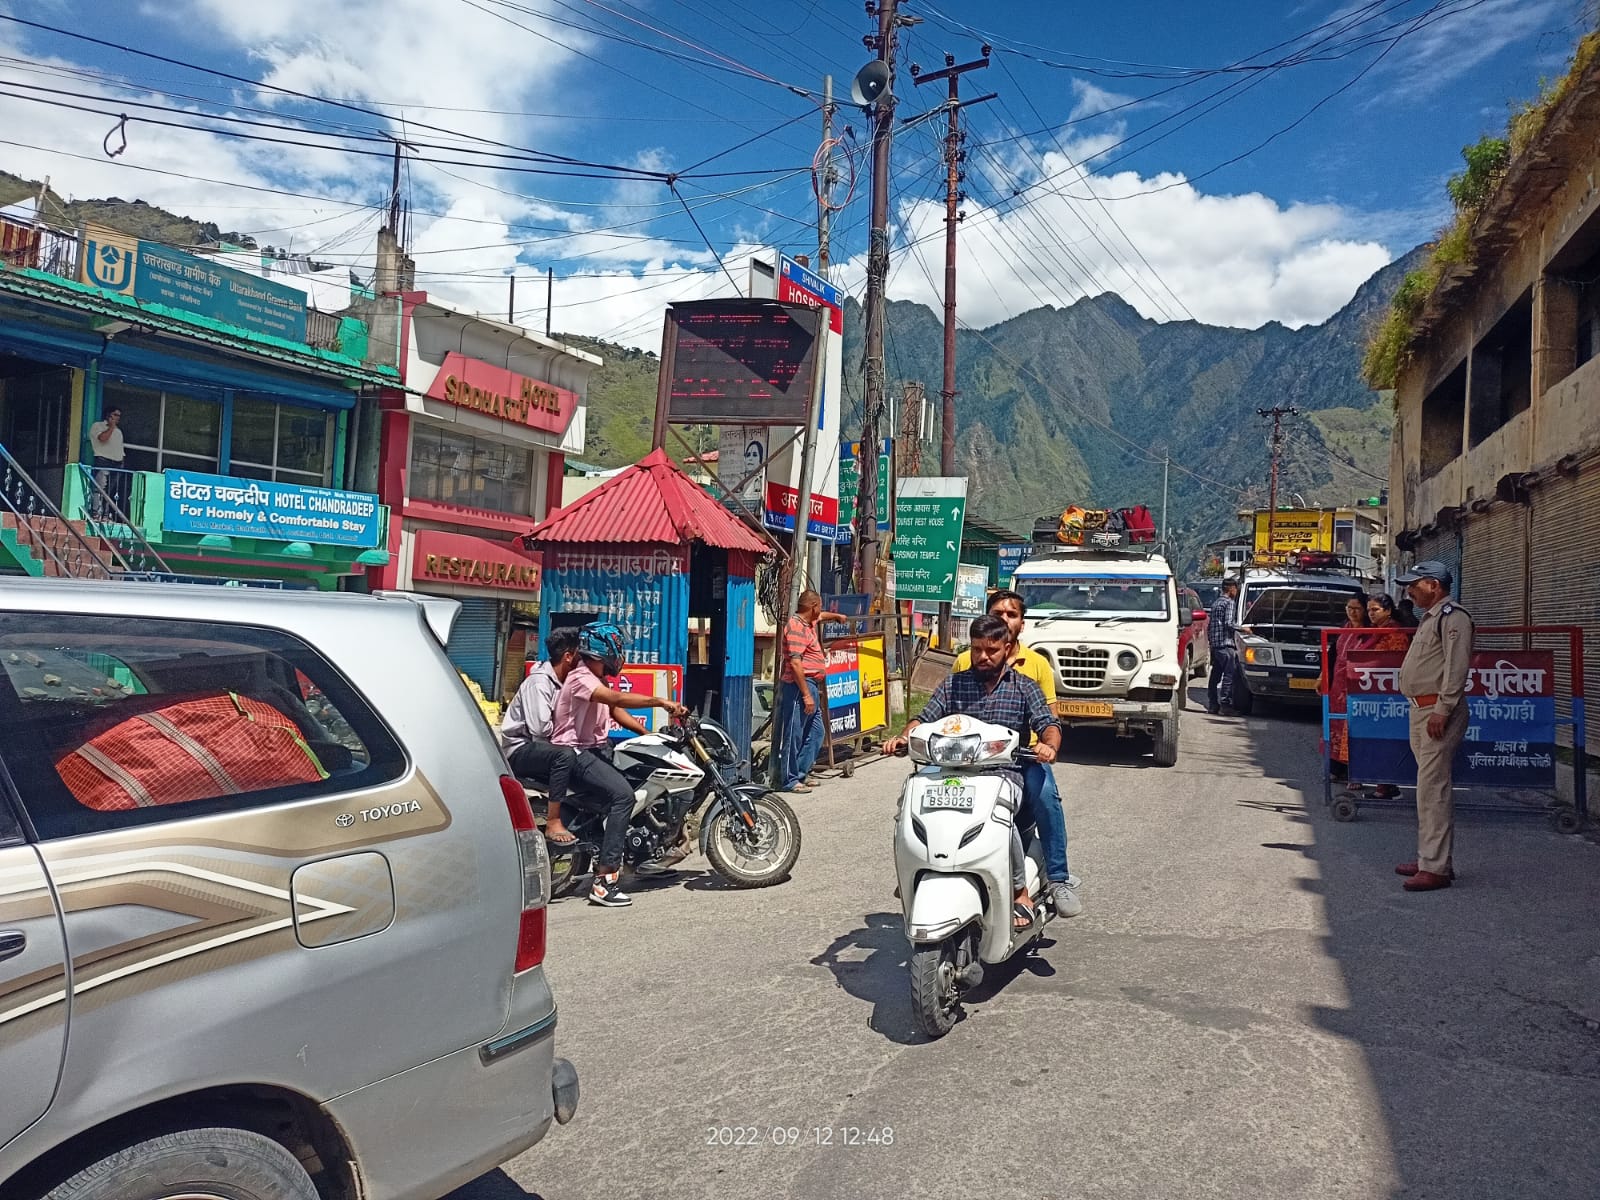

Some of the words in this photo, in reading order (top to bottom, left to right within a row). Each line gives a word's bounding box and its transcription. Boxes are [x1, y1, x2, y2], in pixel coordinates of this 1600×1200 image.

[142, 252, 182, 275] उत्तराखण्ड
[229, 279, 266, 301] Uttarakhand
[802, 272, 826, 295] SHIVALIK
[444, 375, 530, 424] SIDDHARTH
[521, 377, 561, 412] HOTEL
[169, 476, 212, 501] होटल
[214, 483, 270, 507] चन्द्रदीप
[275, 492, 306, 510] HOTEL
[308, 496, 374, 518] CHANDRADEEP
[180, 503, 203, 516] For
[206, 506, 254, 523] Homely
[257, 511, 267, 522] &
[269, 512, 340, 530] Comfortable
[342, 520, 366, 534] Stay
[928, 518, 945, 526] HOUSE
[919, 551, 941, 560] TEMPLE
[425, 553, 538, 583] RESTAURANT
[925, 585, 943, 594] TEMPLE
[1477, 659, 1546, 700] पुलिस
[1468, 752, 1497, 769] पुलिस
[929, 796, 973, 807] BS3029
[937, 786, 966, 797] UK07
[360, 800, 421, 822] TOYOTA
